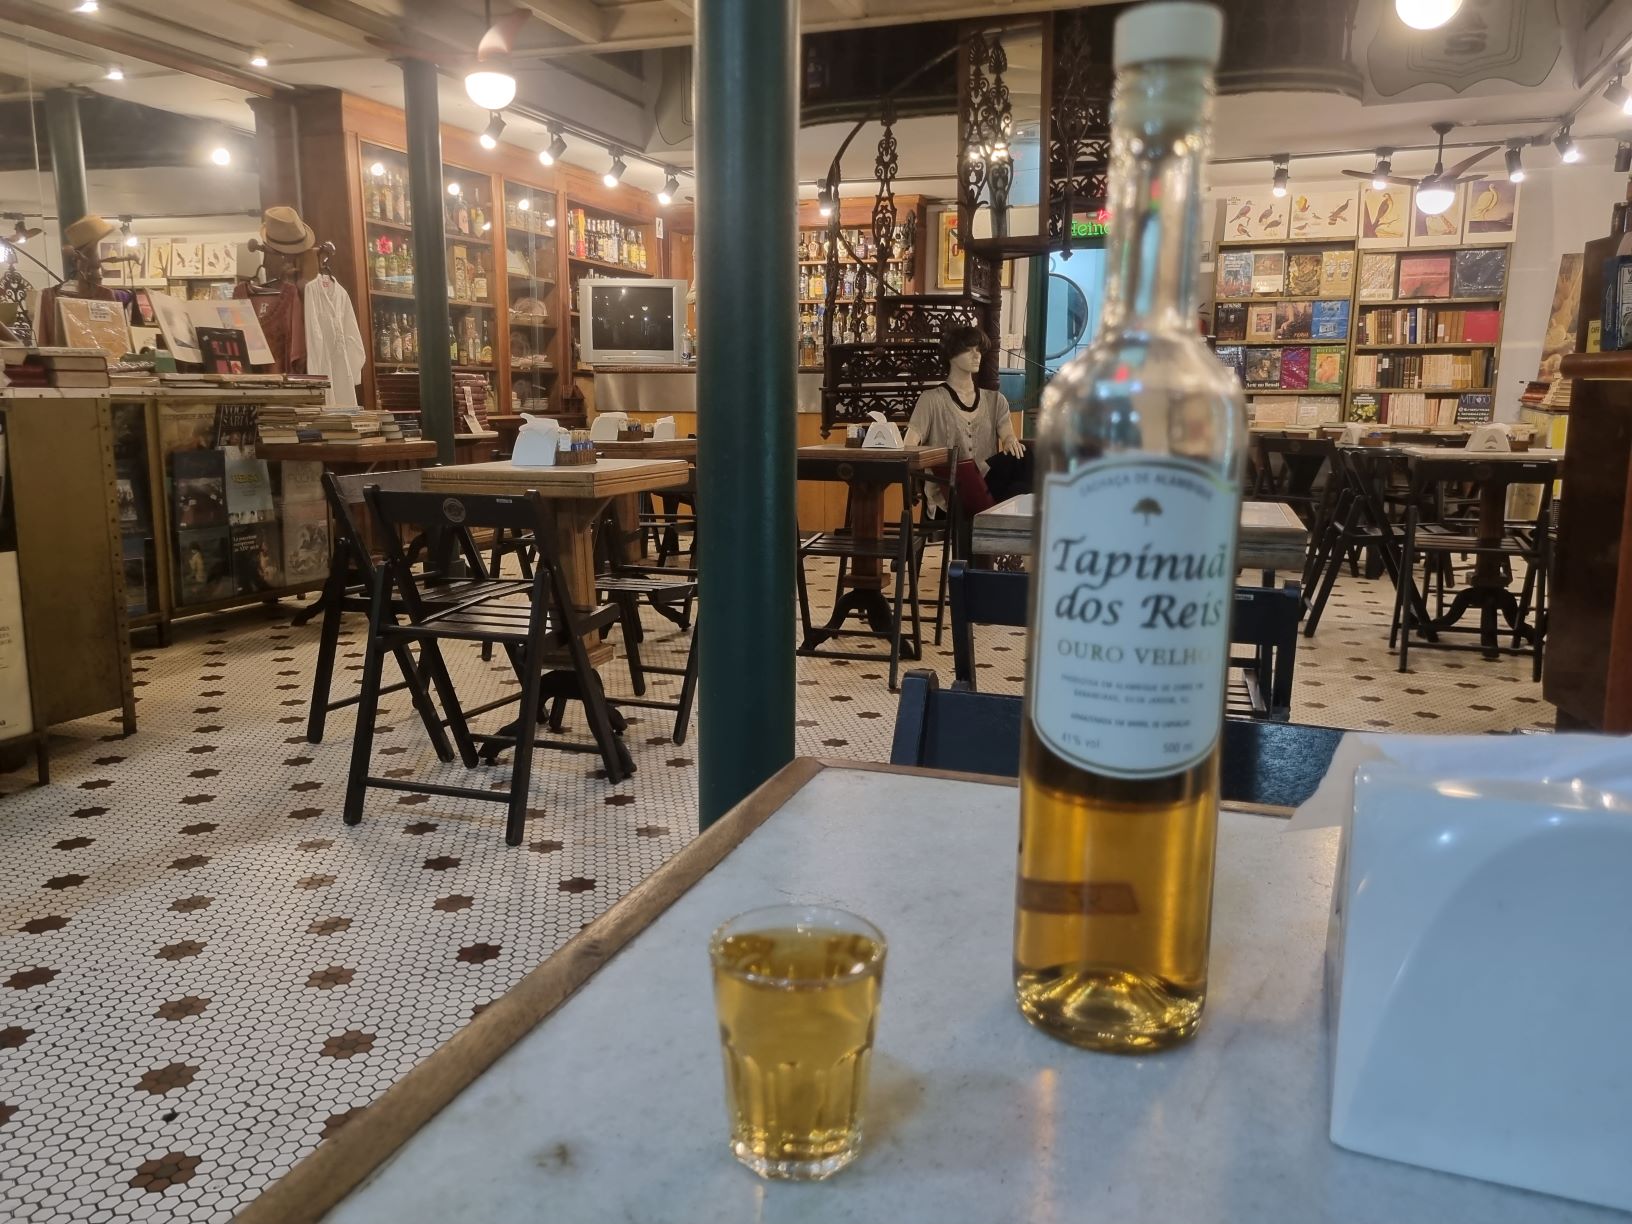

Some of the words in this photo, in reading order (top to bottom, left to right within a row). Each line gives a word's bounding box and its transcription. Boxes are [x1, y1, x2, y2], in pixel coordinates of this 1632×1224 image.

[1134, 472, 1149, 484] DE
[1054, 584, 1123, 626] dos
[1140, 590, 1222, 630] Reis
[1057, 639, 1125, 664] OURO
[1163, 742, 1181, 754] 500
